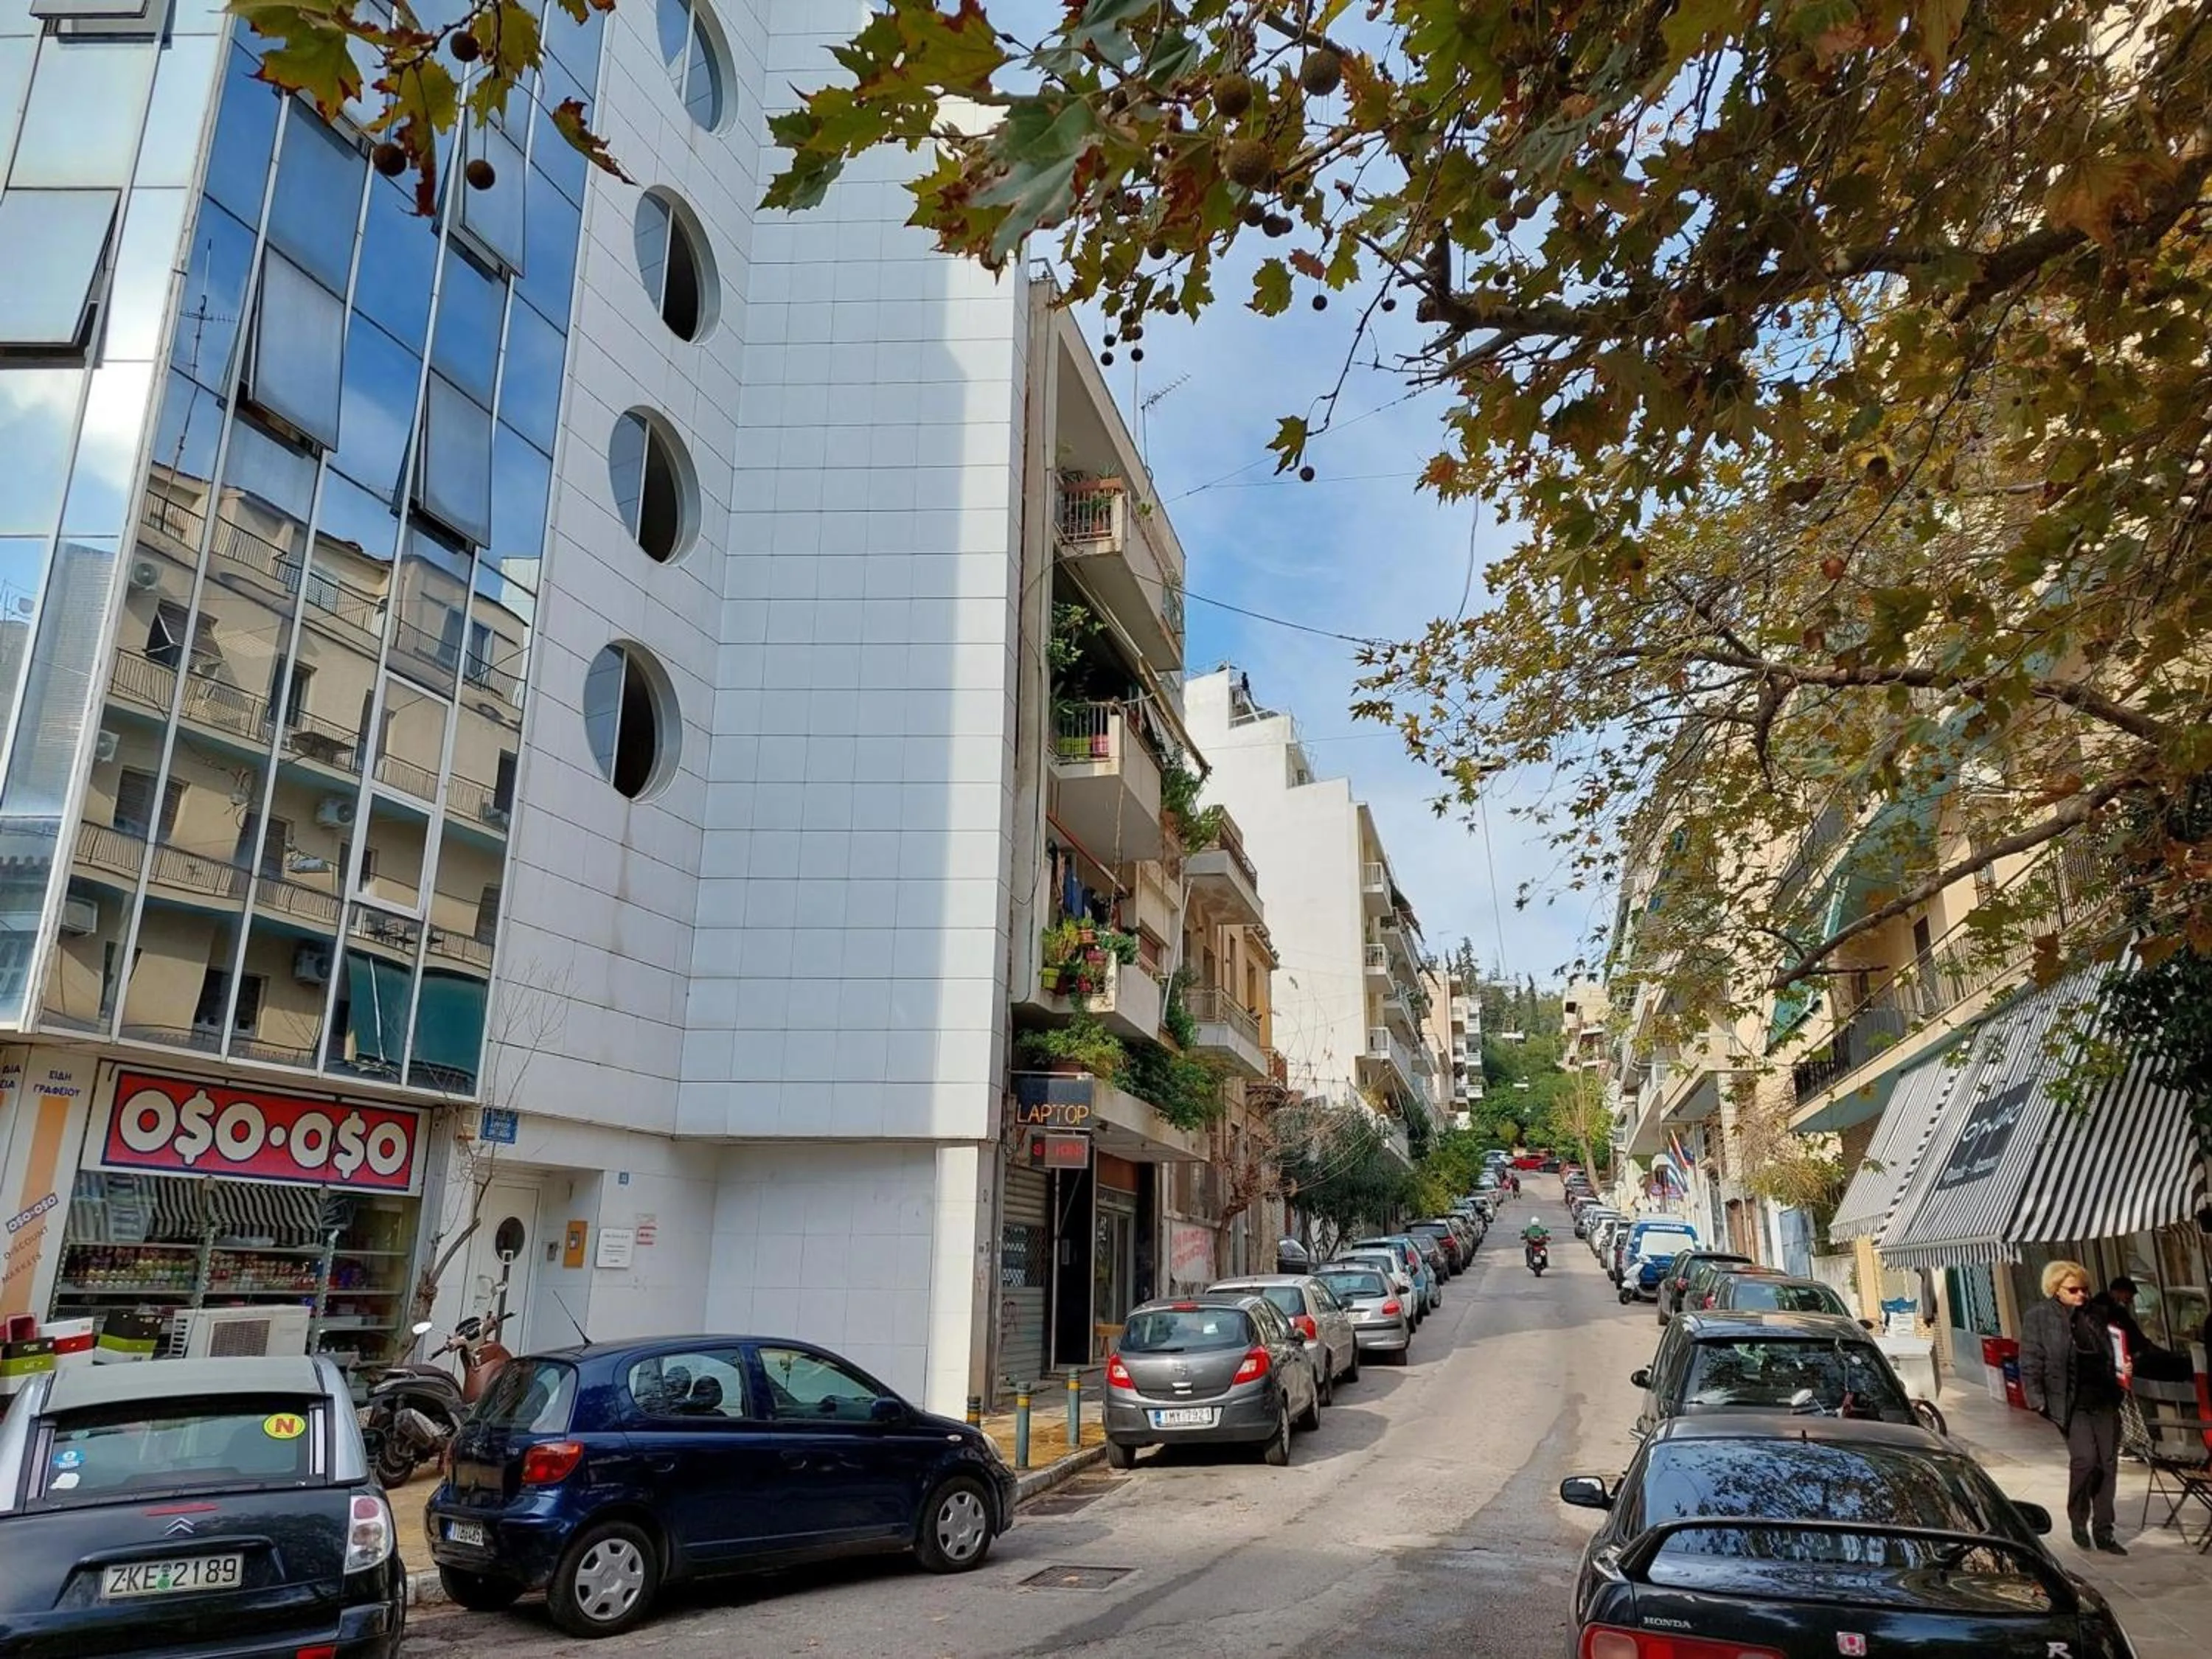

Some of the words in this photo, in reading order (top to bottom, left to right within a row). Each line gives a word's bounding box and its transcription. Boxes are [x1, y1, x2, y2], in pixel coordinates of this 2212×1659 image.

[1018, 1103, 1089, 1125] LAPTOP
[275, 1417, 296, 1434] N
[109, 1565, 158, 1593] ZKE
[173, 1558, 237, 1587] 2189
[1644, 1615, 1692, 1629] HONDA
